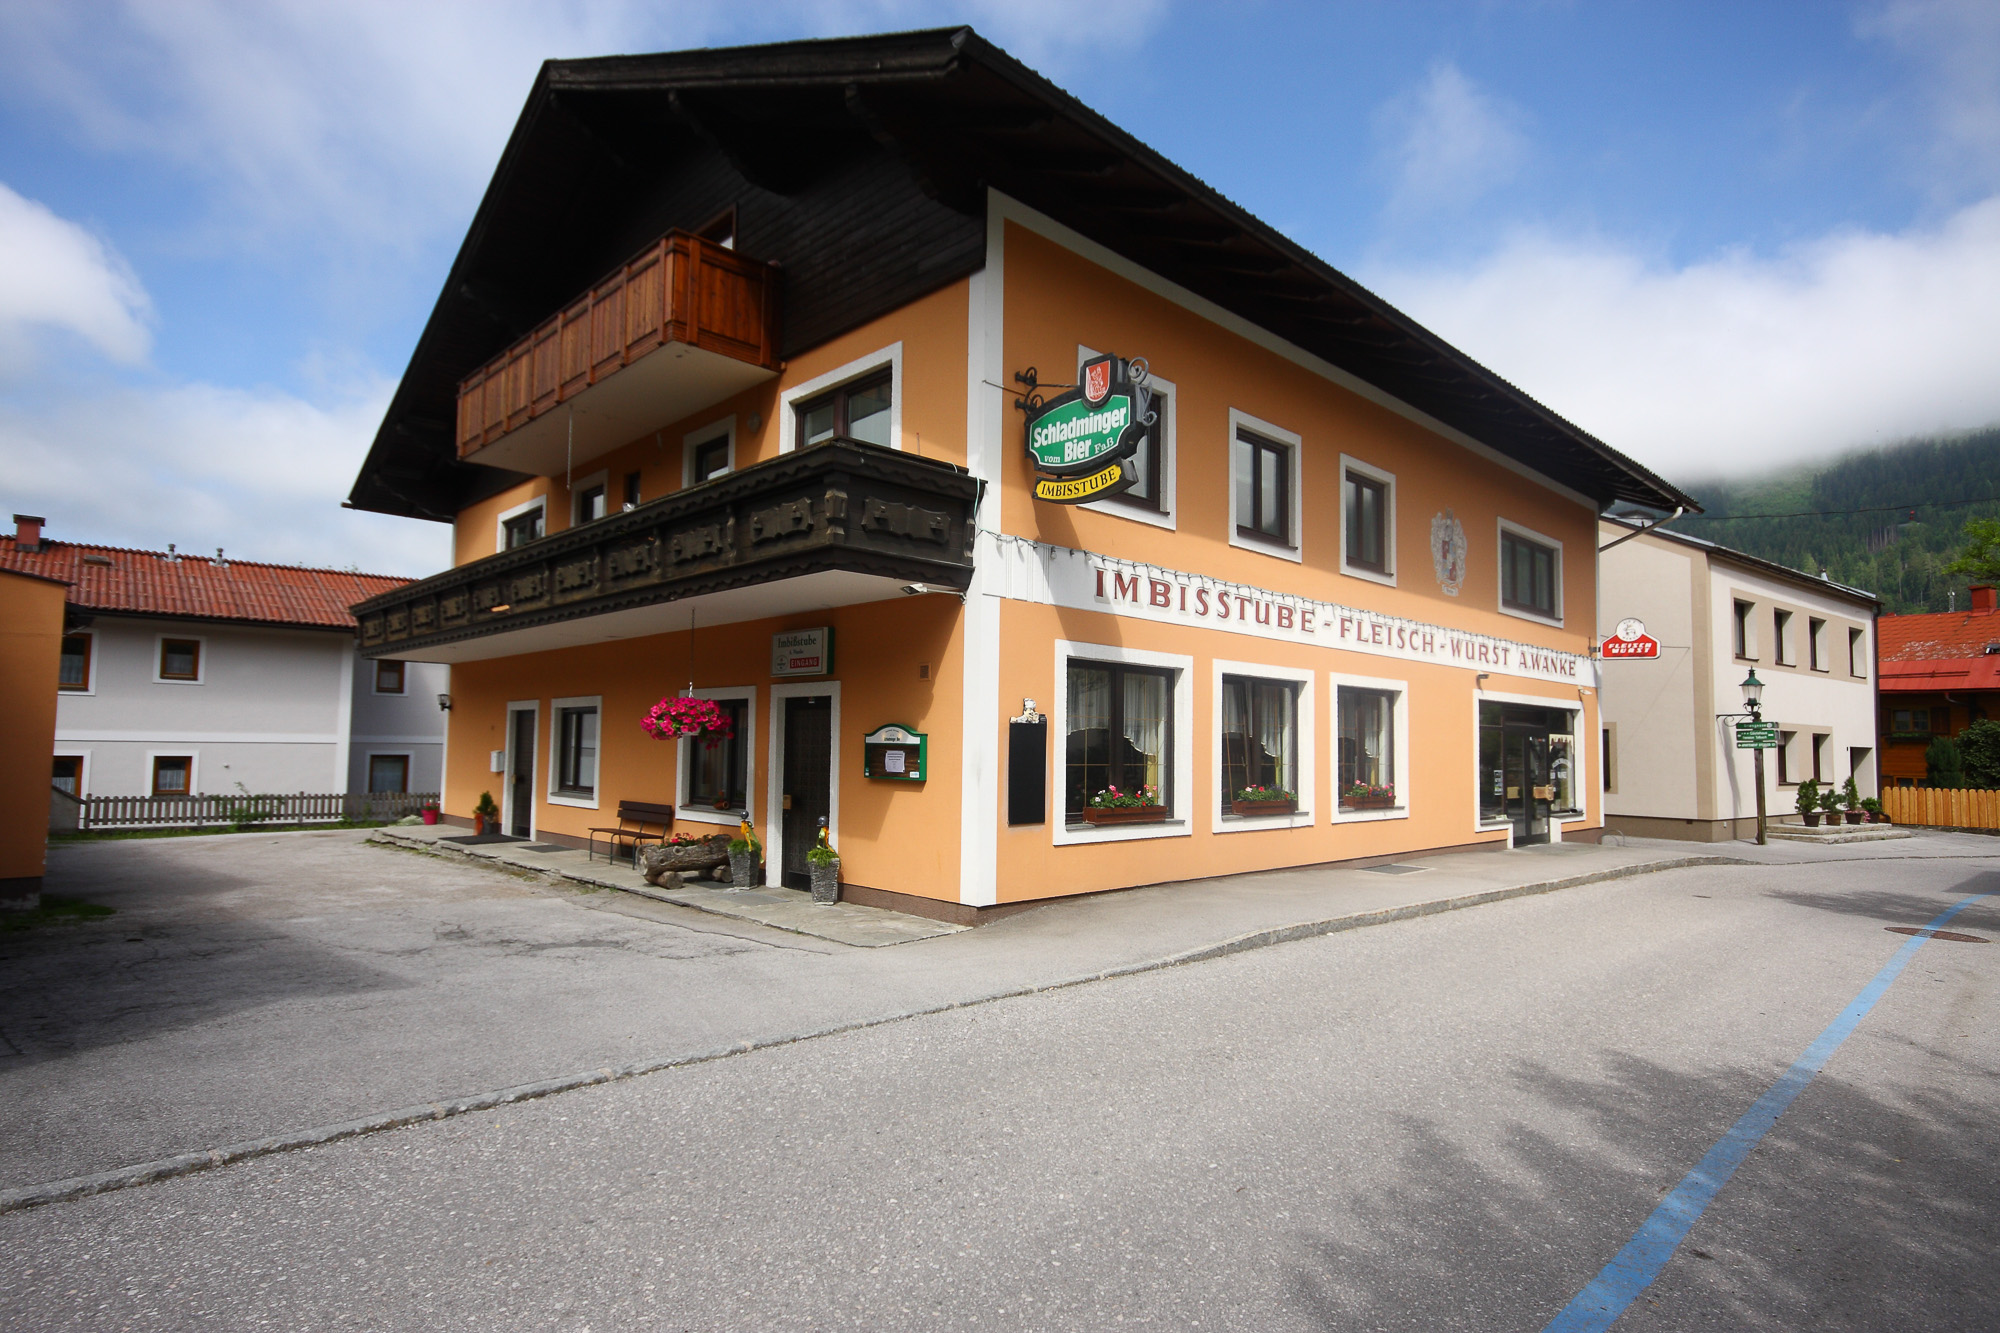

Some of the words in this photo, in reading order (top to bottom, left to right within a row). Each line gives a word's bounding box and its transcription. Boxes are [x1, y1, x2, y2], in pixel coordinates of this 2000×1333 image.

[1033, 406, 1127, 448] Schladminger
[1044, 454, 1061, 463] vom
[1064, 438, 1092, 462] Bier
[1094, 436, 1114, 455] Faß
[1041, 469, 1116, 496] IMBISSTUBE
[778, 634, 817, 648] Imbißstube
[791, 658, 818, 667] EINGANG
